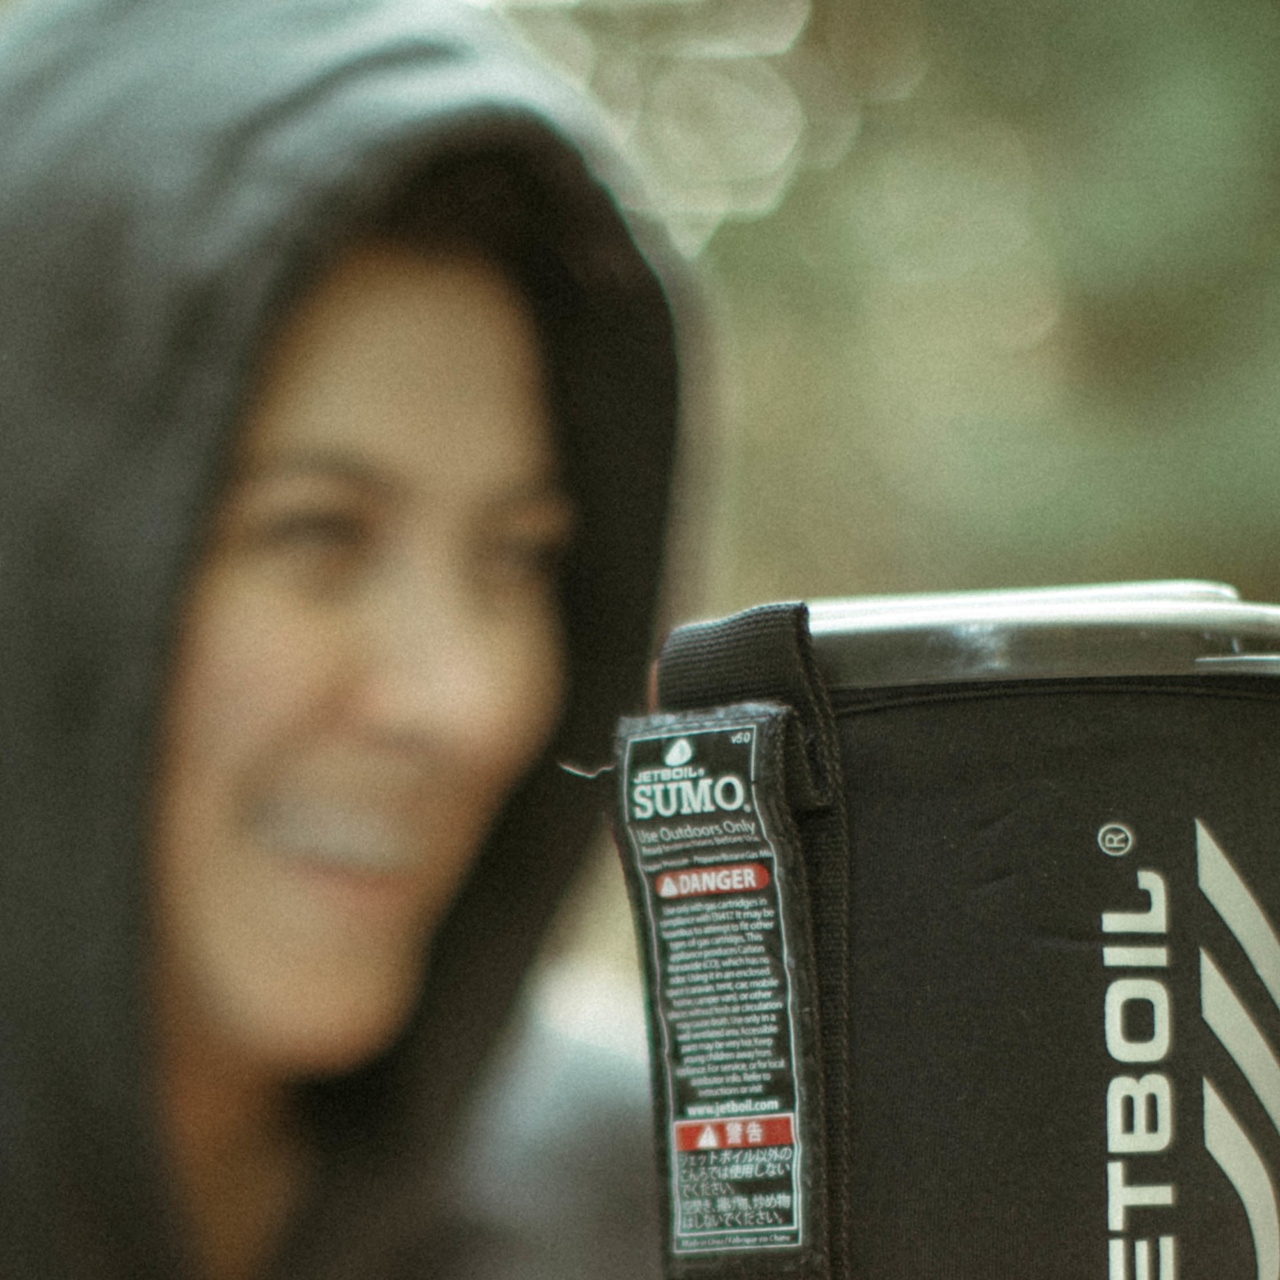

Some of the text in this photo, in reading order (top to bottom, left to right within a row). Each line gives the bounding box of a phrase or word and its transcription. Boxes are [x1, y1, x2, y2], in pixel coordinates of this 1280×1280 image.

[637, 820, 756, 844] Use Outdoors Only
[679, 869, 756, 894] DANGER
[718, 898, 756, 911] cartridges
[763, 908, 774, 917] be
[750, 920, 774, 929] other
[745, 932, 762, 942] This
[721, 957, 745, 967] which
[734, 966, 770, 977] enclosed
[750, 978, 779, 988] mobile
[749, 990, 773, 999] other
[741, 1000, 783, 1012] circulation
[744, 1014, 761, 1024] only
[762, 1014, 769, 1022] in
[740, 1024, 778, 1036] Accessible
[754, 1037, 773, 1047] Keep
[769, 1058, 785, 1068] local
[763, 1072, 770, 1080] to
[687, 1099, 779, 1117] www.jetboil.com
[726, 1122, 763, 1145] 警告
